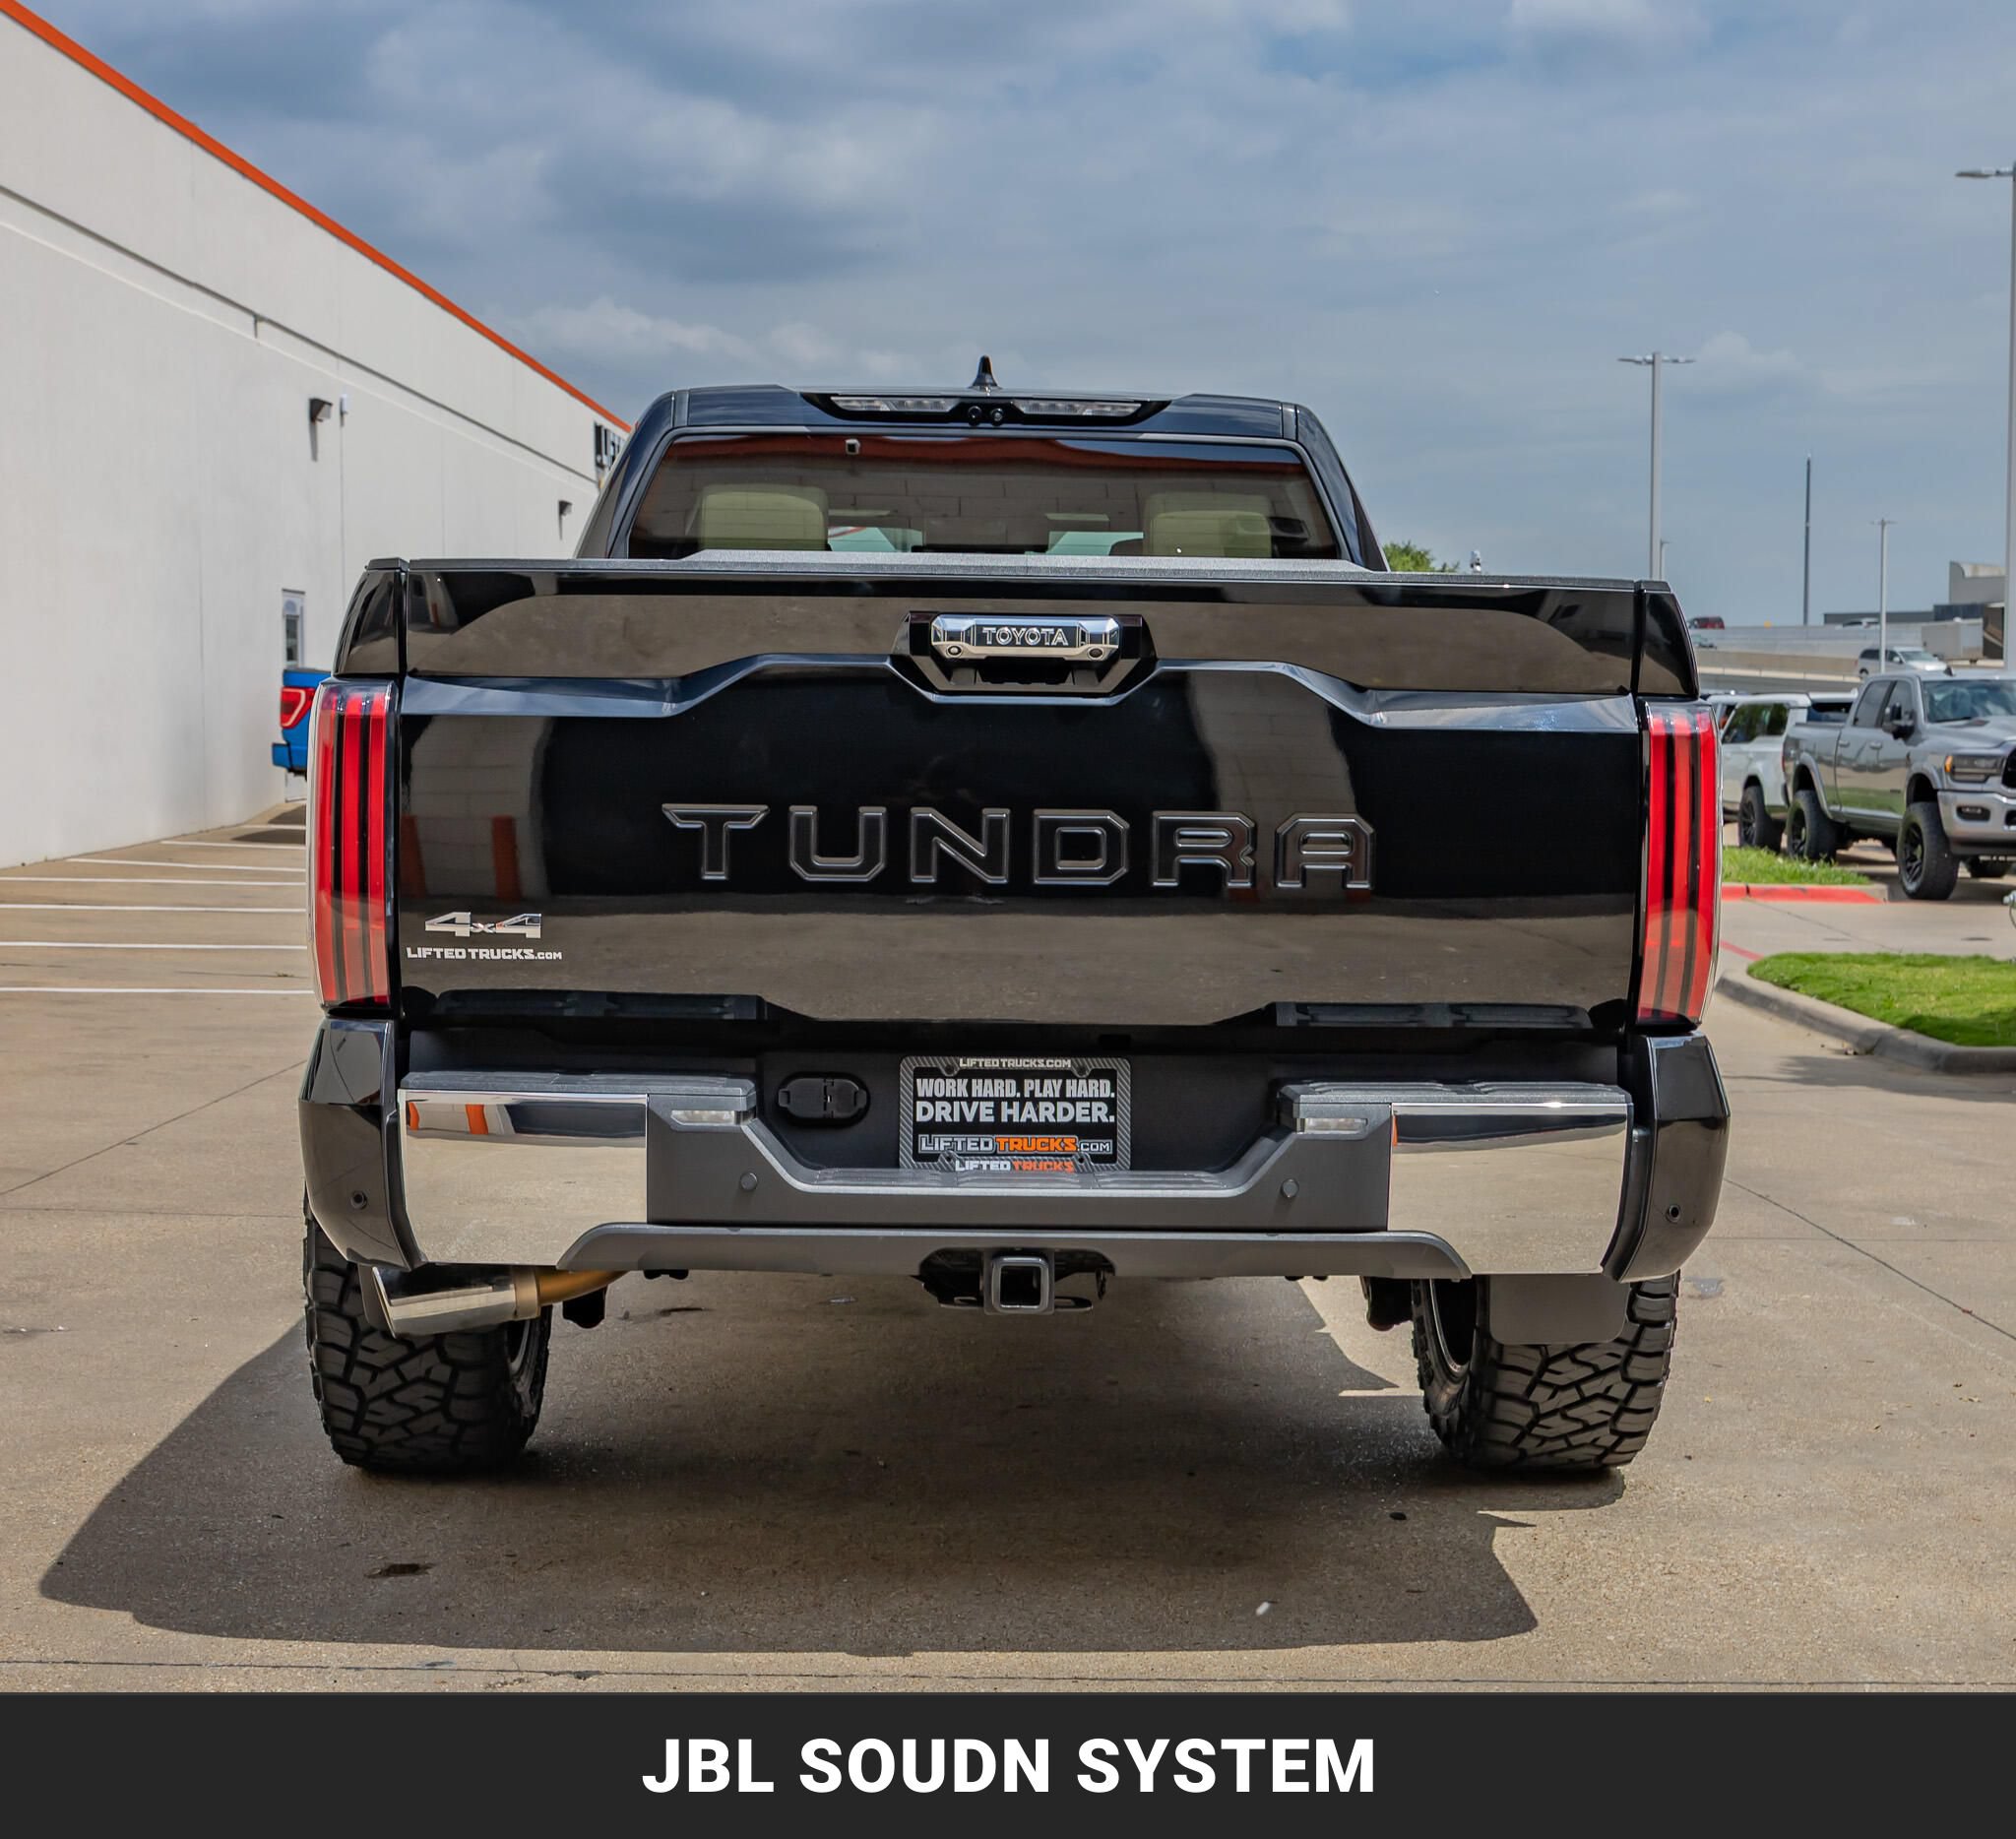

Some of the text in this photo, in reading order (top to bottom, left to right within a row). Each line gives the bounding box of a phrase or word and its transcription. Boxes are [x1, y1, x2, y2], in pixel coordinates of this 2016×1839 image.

[982, 626, 1069, 646] TOYOTA
[662, 803, 1375, 888] TUNDRA
[915, 1078, 1115, 1099] WORK HARD. PLAY HARD.
[915, 1101, 1115, 1122] DRIVE HARDER.
[955, 1160, 1075, 1173] LIFTED TRUCKS
